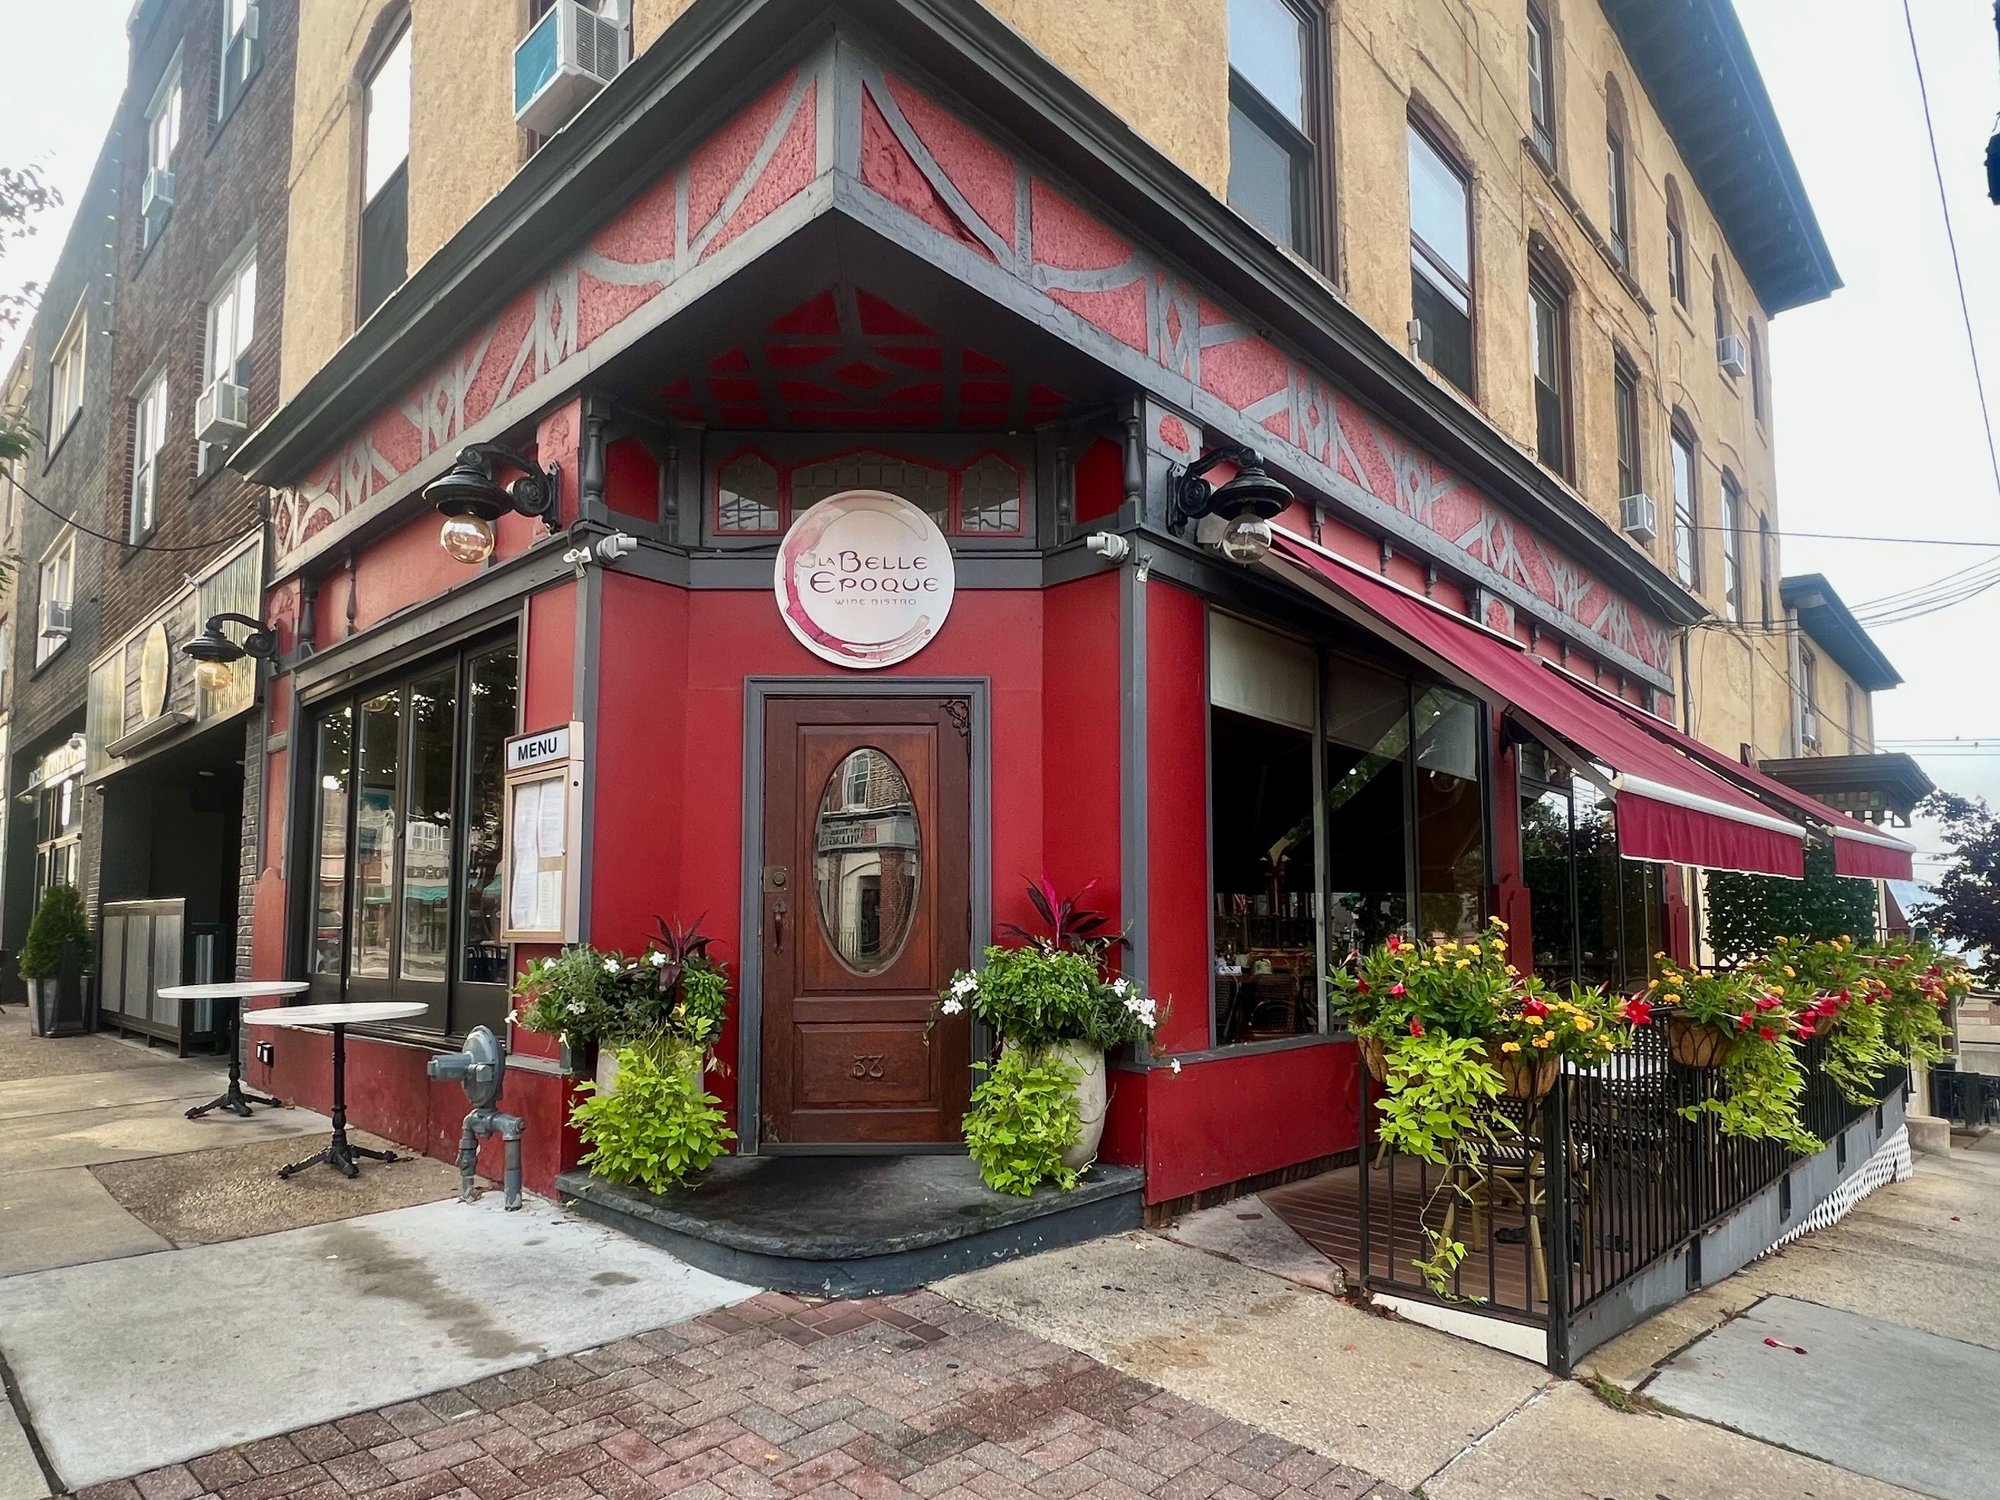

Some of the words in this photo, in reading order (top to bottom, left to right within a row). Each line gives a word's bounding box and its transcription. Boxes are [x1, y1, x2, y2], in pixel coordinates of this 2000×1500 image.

[818, 557, 836, 567] LA
[838, 550, 928, 572] BELLE
[809, 571, 939, 593] EPOQUE
[834, 598, 866, 606] WINE
[871, 598, 917, 606] BISTRO
[517, 736, 557, 761] MENU
